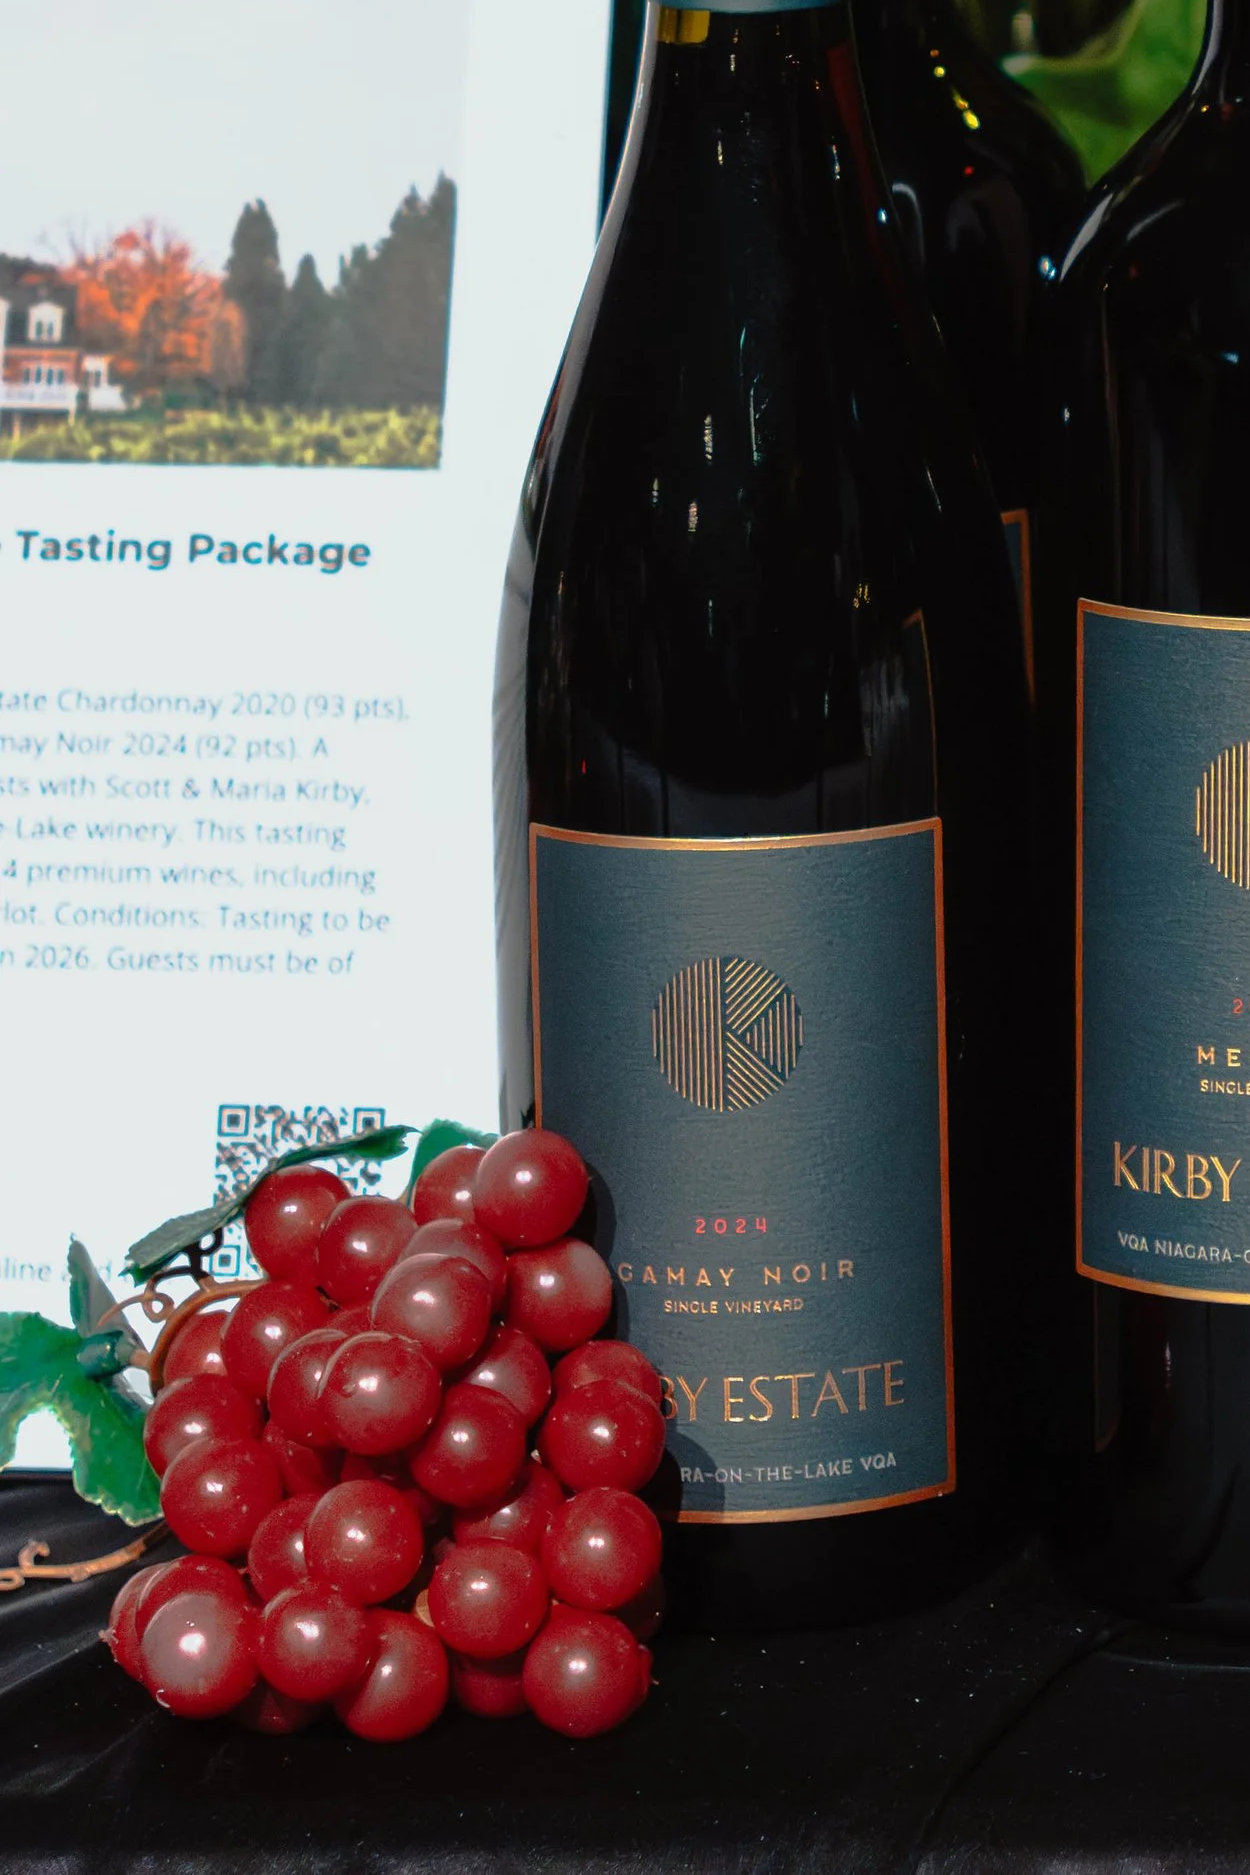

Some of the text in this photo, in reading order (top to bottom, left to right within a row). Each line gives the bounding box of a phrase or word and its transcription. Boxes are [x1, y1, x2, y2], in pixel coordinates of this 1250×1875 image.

[16, 528, 371, 574] Tasting Package
[57, 688, 222, 720] Chardonnay
[233, 692, 296, 716] 2020
[304, 694, 344, 721] (93
[58, 732, 112, 757] Noir
[123, 734, 186, 757] 2024
[196, 735, 236, 760] (92
[313, 737, 328, 759] A
[39, 776, 96, 797] with
[106, 775, 170, 799] Scott
[182, 778, 200, 799] &
[211, 778, 285, 802] Maria
[195, 818, 246, 843] This
[256, 824, 347, 853] tasting
[3, 859, 16, 878] 4
[27, 862, 151, 888] premium
[255, 863, 376, 896] including
[219, 905, 313, 938] Tasting
[322, 910, 349, 931] to
[358, 908, 391, 932] be
[107, 945, 200, 972] Guests
[209, 952, 275, 974] must
[287, 949, 319, 975] be
[328, 950, 355, 975] of
[1113, 1141, 1241, 1202] KIRBY
[695, 1217, 768, 1235] 2024
[1118, 1230, 1149, 1253] VQA
[4, 1257, 52, 1283] line
[617, 1259, 856, 1287] GAMAY NOIR
[664, 1298, 805, 1315] SINGLE VINEYARD
[723, 1360, 905, 1423] ESTATE
[681, 1452, 897, 1484] RA-ON-THE-LAKE VQA
